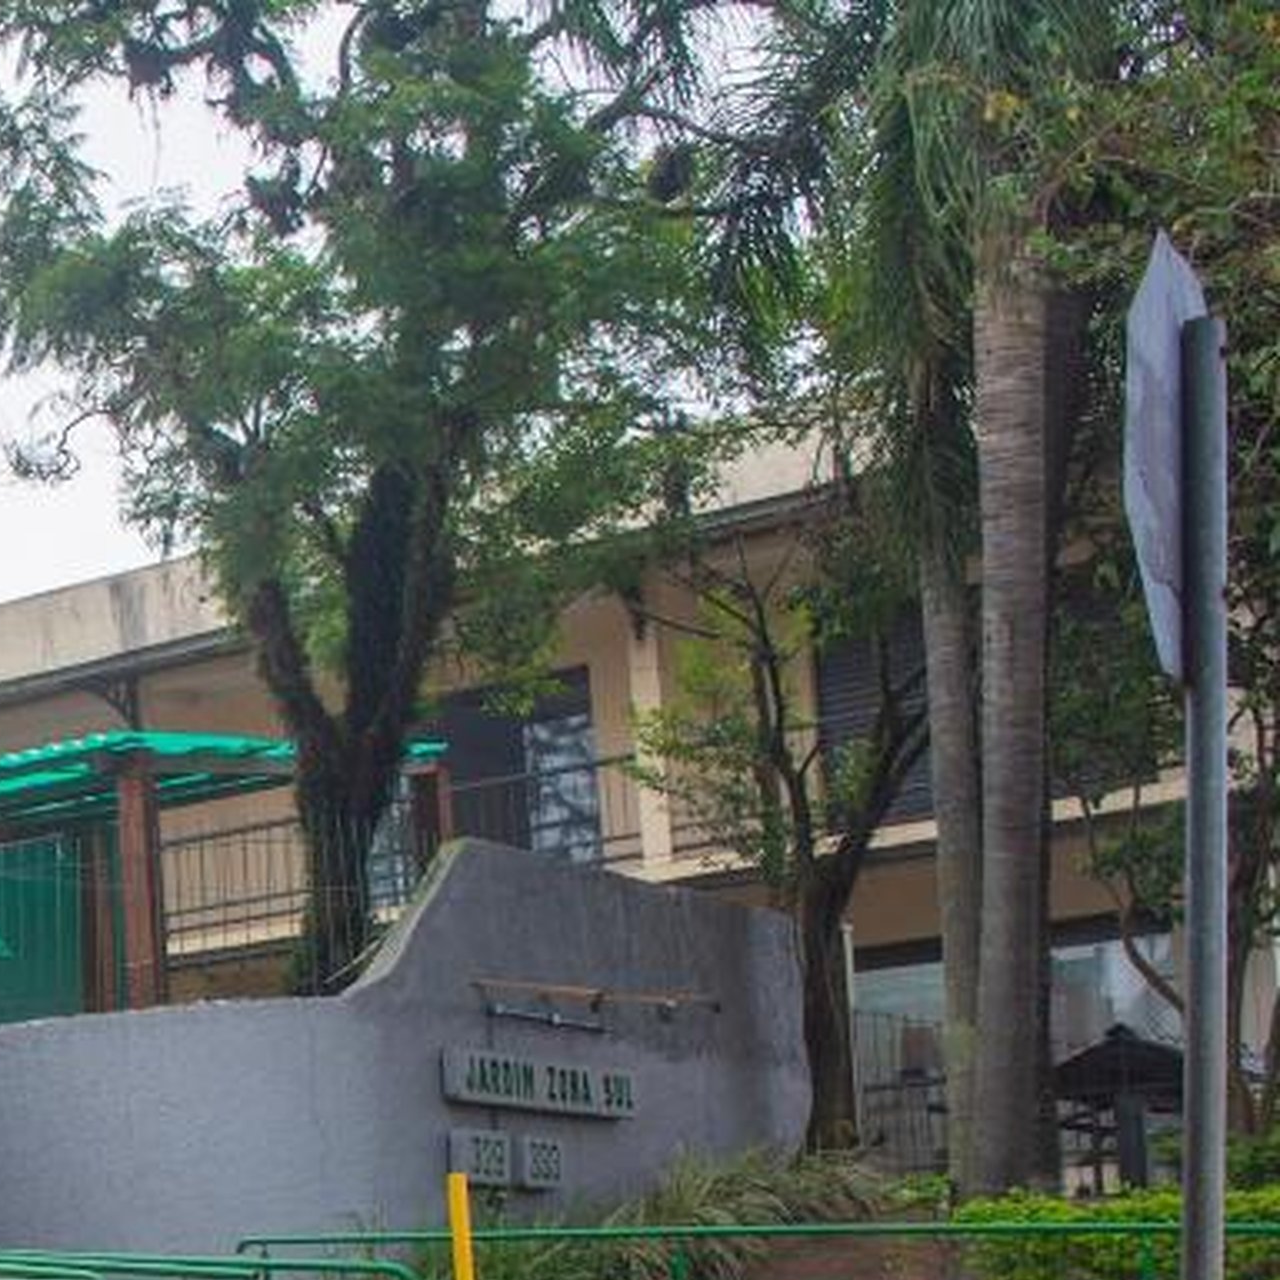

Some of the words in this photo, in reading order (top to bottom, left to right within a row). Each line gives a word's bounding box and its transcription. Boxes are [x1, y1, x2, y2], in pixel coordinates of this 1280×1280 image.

[466, 1054, 535, 1100] JARDIM
[546, 1065, 593, 1106] ZONA
[601, 1073, 635, 1110] SUL
